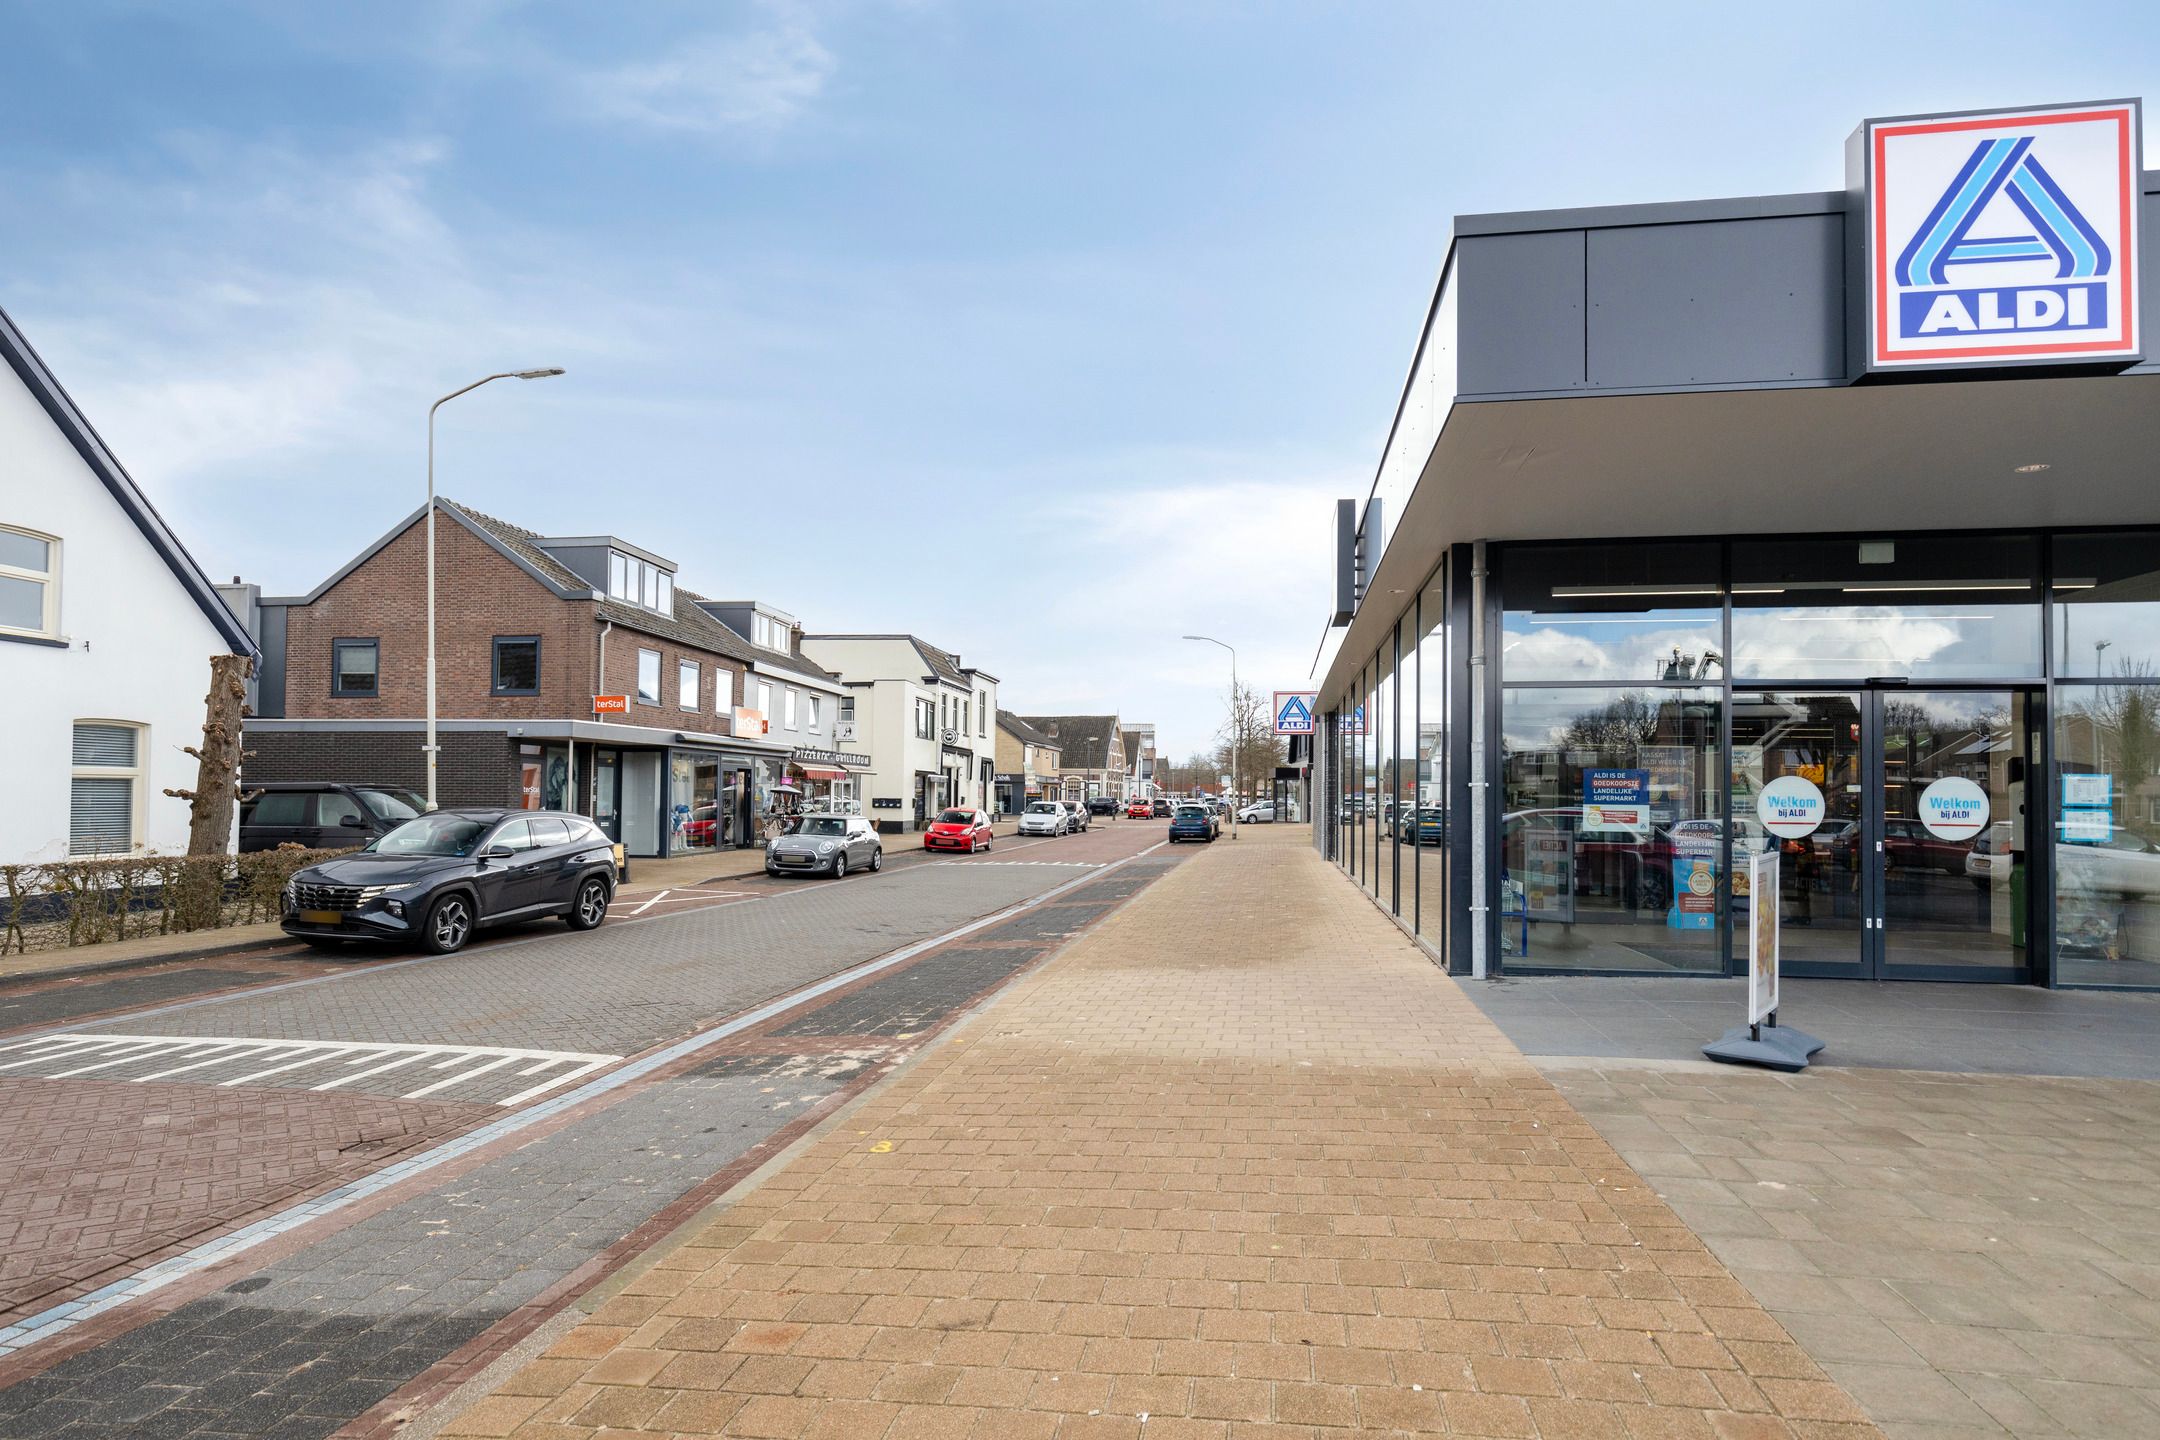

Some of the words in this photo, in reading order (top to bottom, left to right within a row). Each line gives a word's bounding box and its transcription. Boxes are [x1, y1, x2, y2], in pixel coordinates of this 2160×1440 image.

[1918, 287, 2089, 334] ALDI
[596, 699, 624, 708] terStal
[796, 749, 828, 761] PIZZERIA
[835, 754, 869, 765] GRILLROOM
[1768, 796, 1817, 808] Welkom
[1930, 797, 1981, 809] Welkom
[1778, 809, 1788, 818] bij
[1789, 809, 1806, 817] ALDI
[1940, 811, 1951, 820] bij
